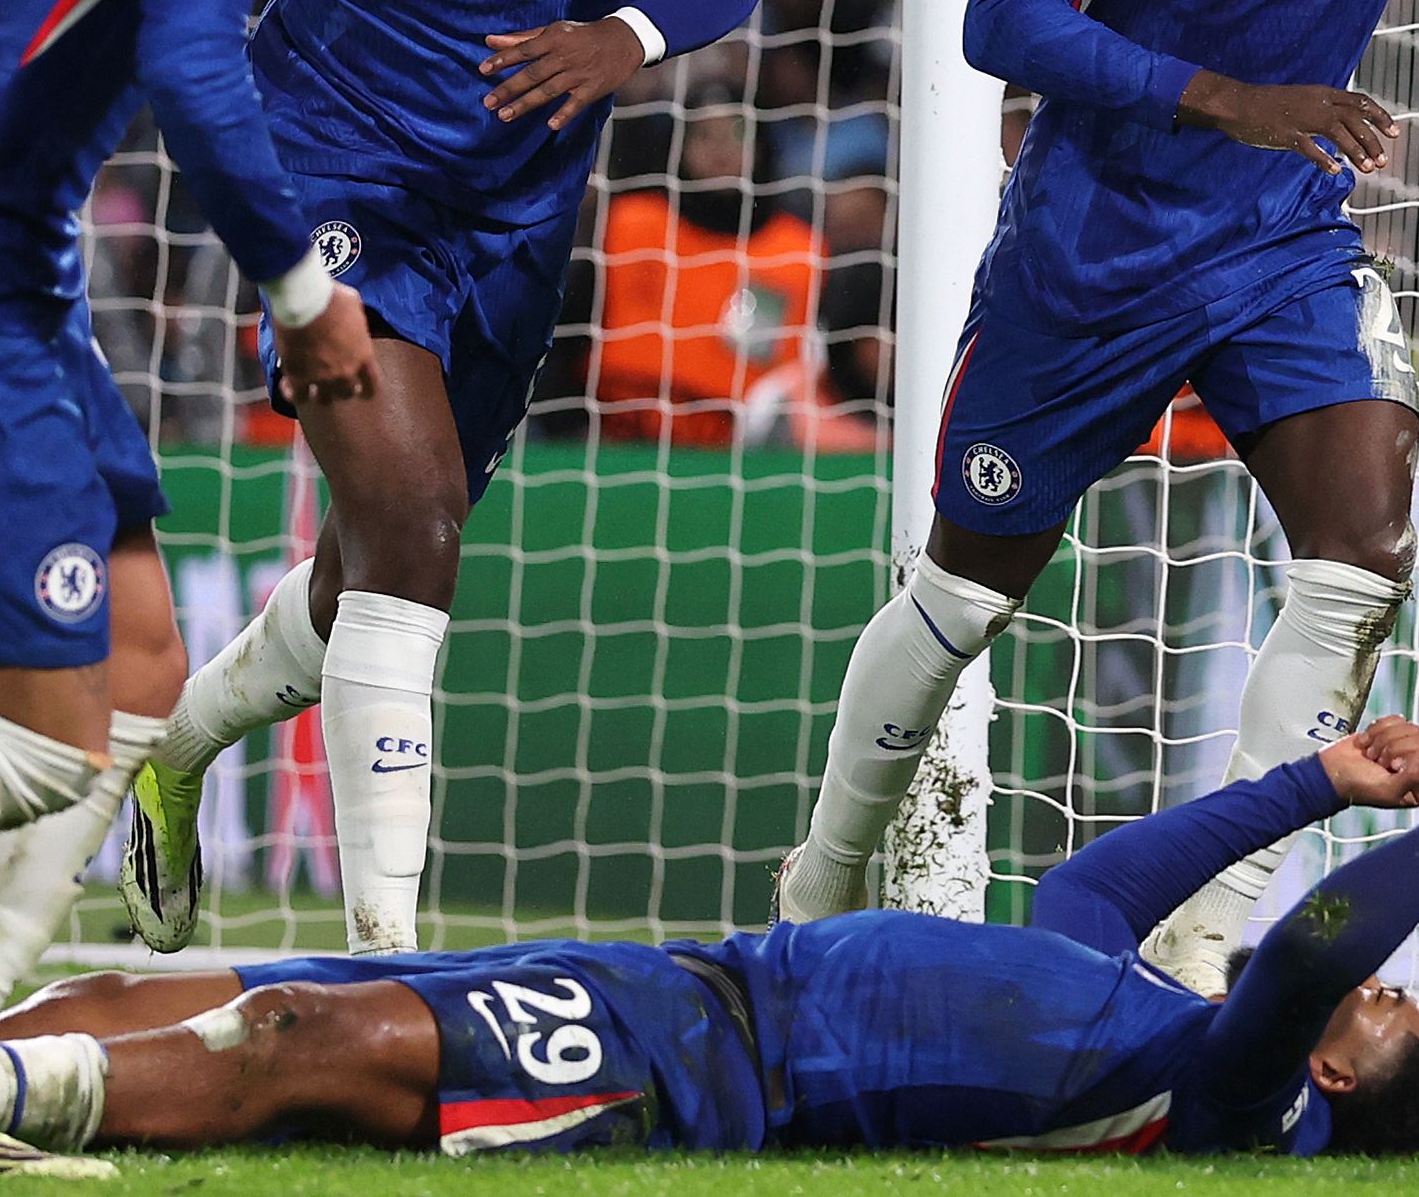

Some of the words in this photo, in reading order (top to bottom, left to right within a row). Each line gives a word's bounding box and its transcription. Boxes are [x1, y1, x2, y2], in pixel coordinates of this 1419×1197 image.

[972, 446, 1010, 464] CHELSEA
[375, 736, 428, 758] CFC
[491, 977, 603, 1085] 29
